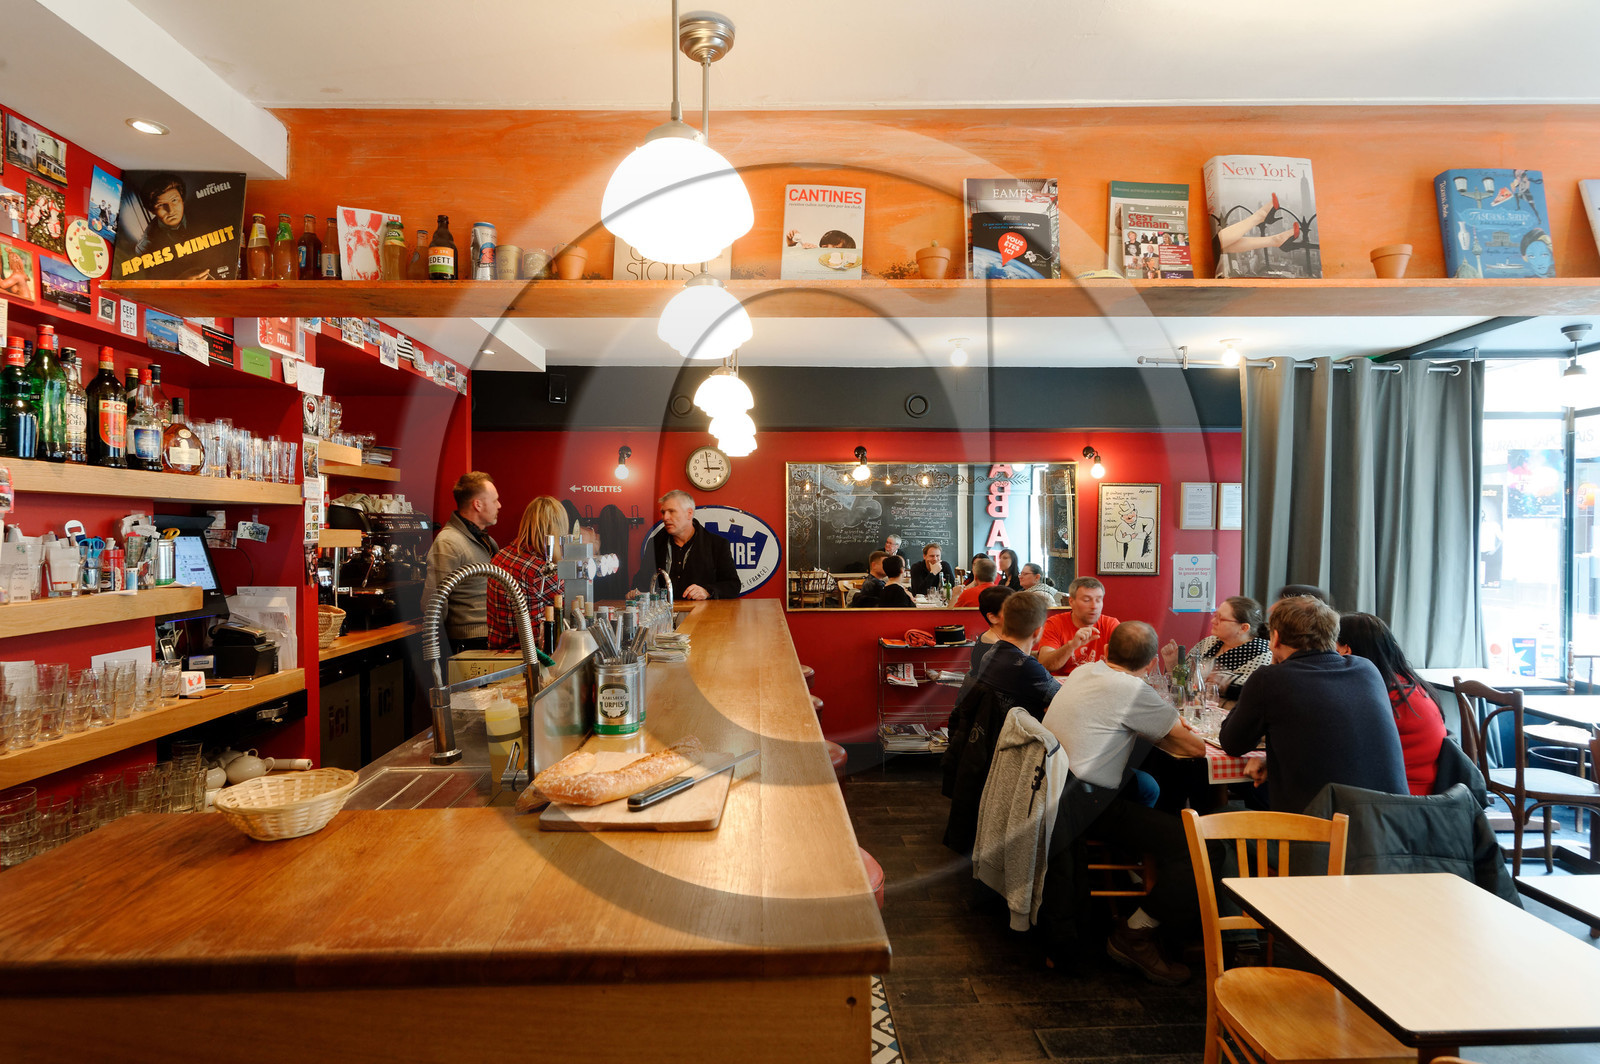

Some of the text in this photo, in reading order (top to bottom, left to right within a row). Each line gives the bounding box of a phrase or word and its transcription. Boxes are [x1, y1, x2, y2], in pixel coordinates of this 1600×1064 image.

[1222, 162, 1296, 178] New York
[195, 181, 231, 199] MITCHELL
[789, 188, 862, 204] CANTINES
[992, 188, 1034, 198] EAMES
[1007, 235, 1024, 246] VOUS
[121, 225, 234, 277] APRES MINUIT
[122, 304, 135, 316] CECI
[122, 319, 135, 330] CECI
[582, 485, 622, 493] TOILETTES
[1103, 561, 1153, 570] LOTERIE NATIONALE
[746, 566, 770, 586] (FRANCE)
